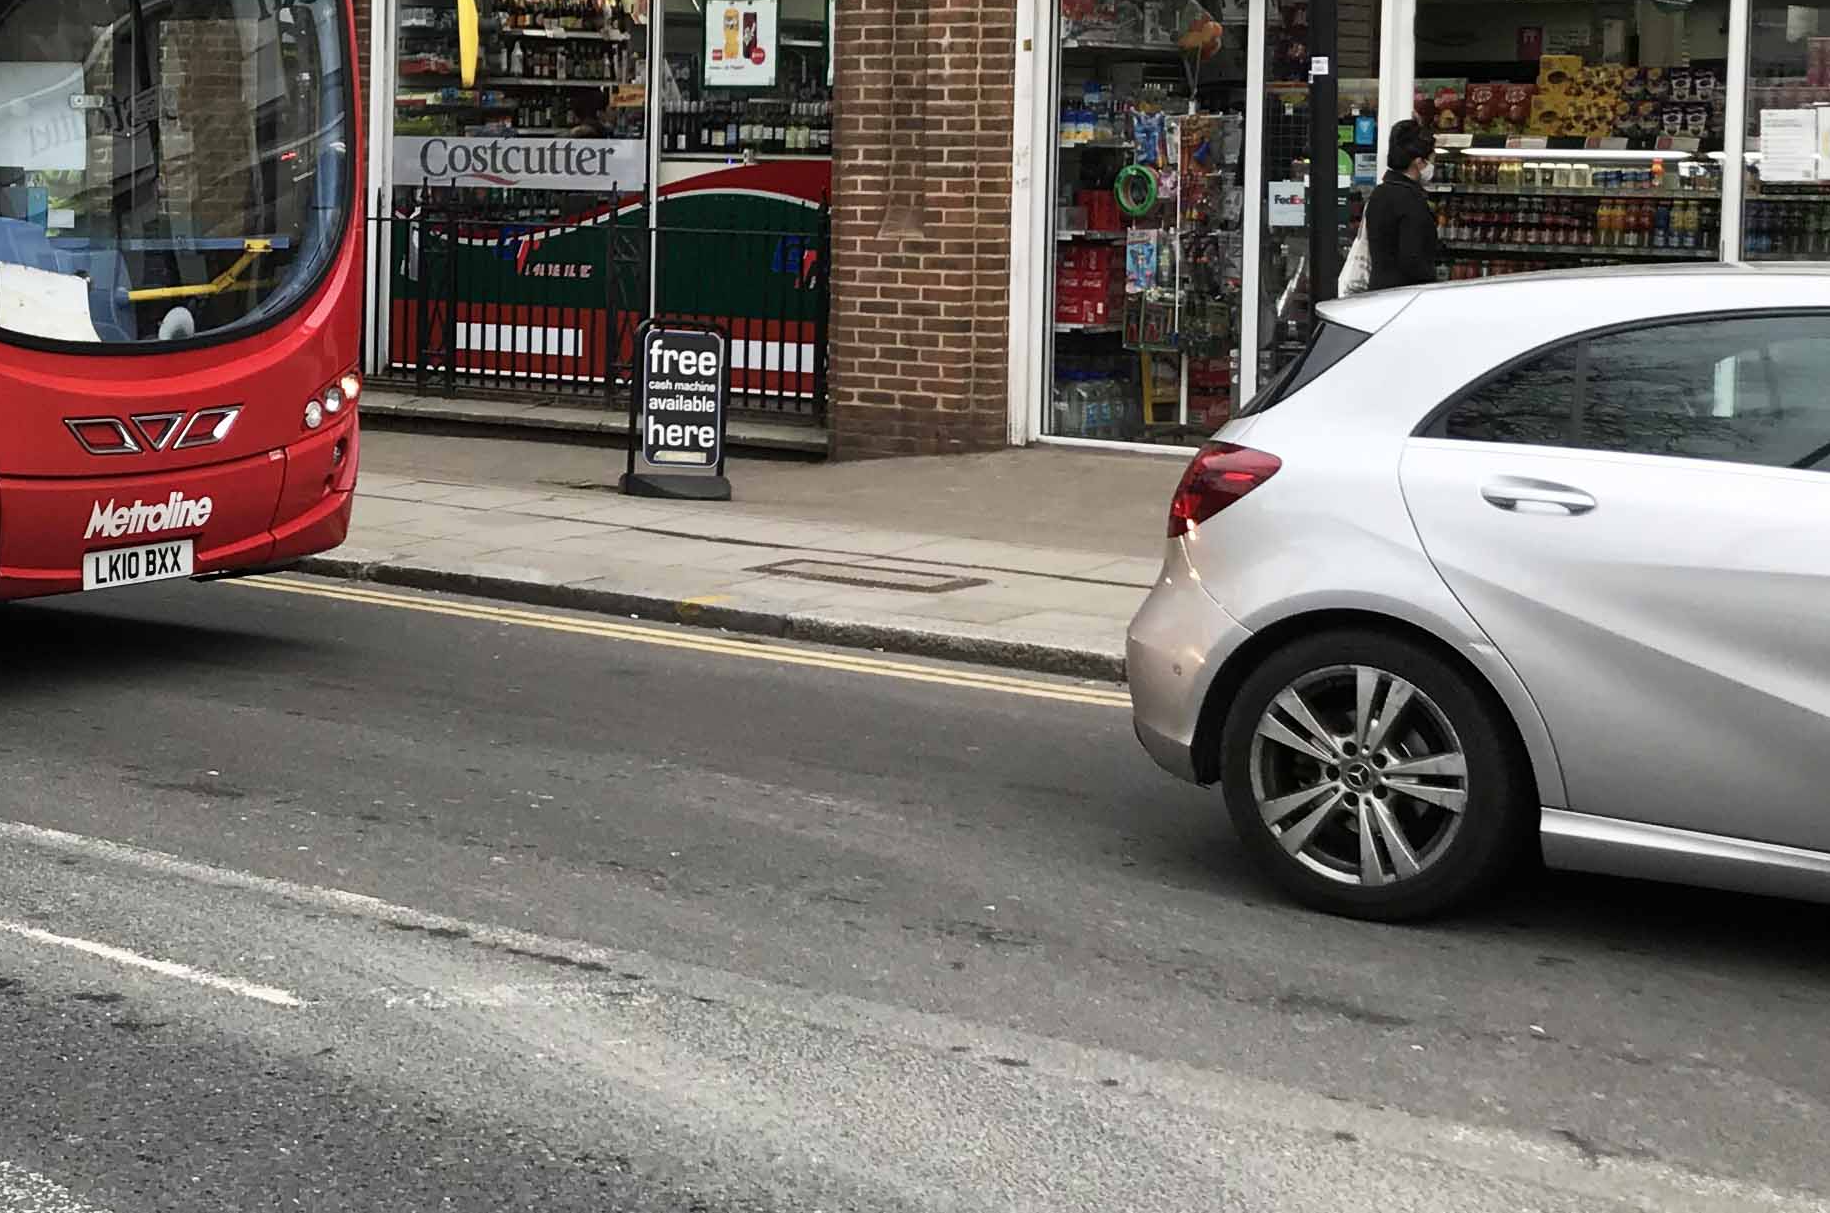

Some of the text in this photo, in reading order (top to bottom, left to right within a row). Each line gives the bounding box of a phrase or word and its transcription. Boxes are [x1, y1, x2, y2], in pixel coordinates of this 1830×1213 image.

[420, 138, 615, 177] Costcutter
[649, 339, 717, 377] free
[648, 379, 716, 393] cash machine
[648, 394, 716, 413] available
[647, 414, 715, 448] here
[83, 491, 213, 540] Metroline
[94, 545, 182, 586] LK10 BXX
